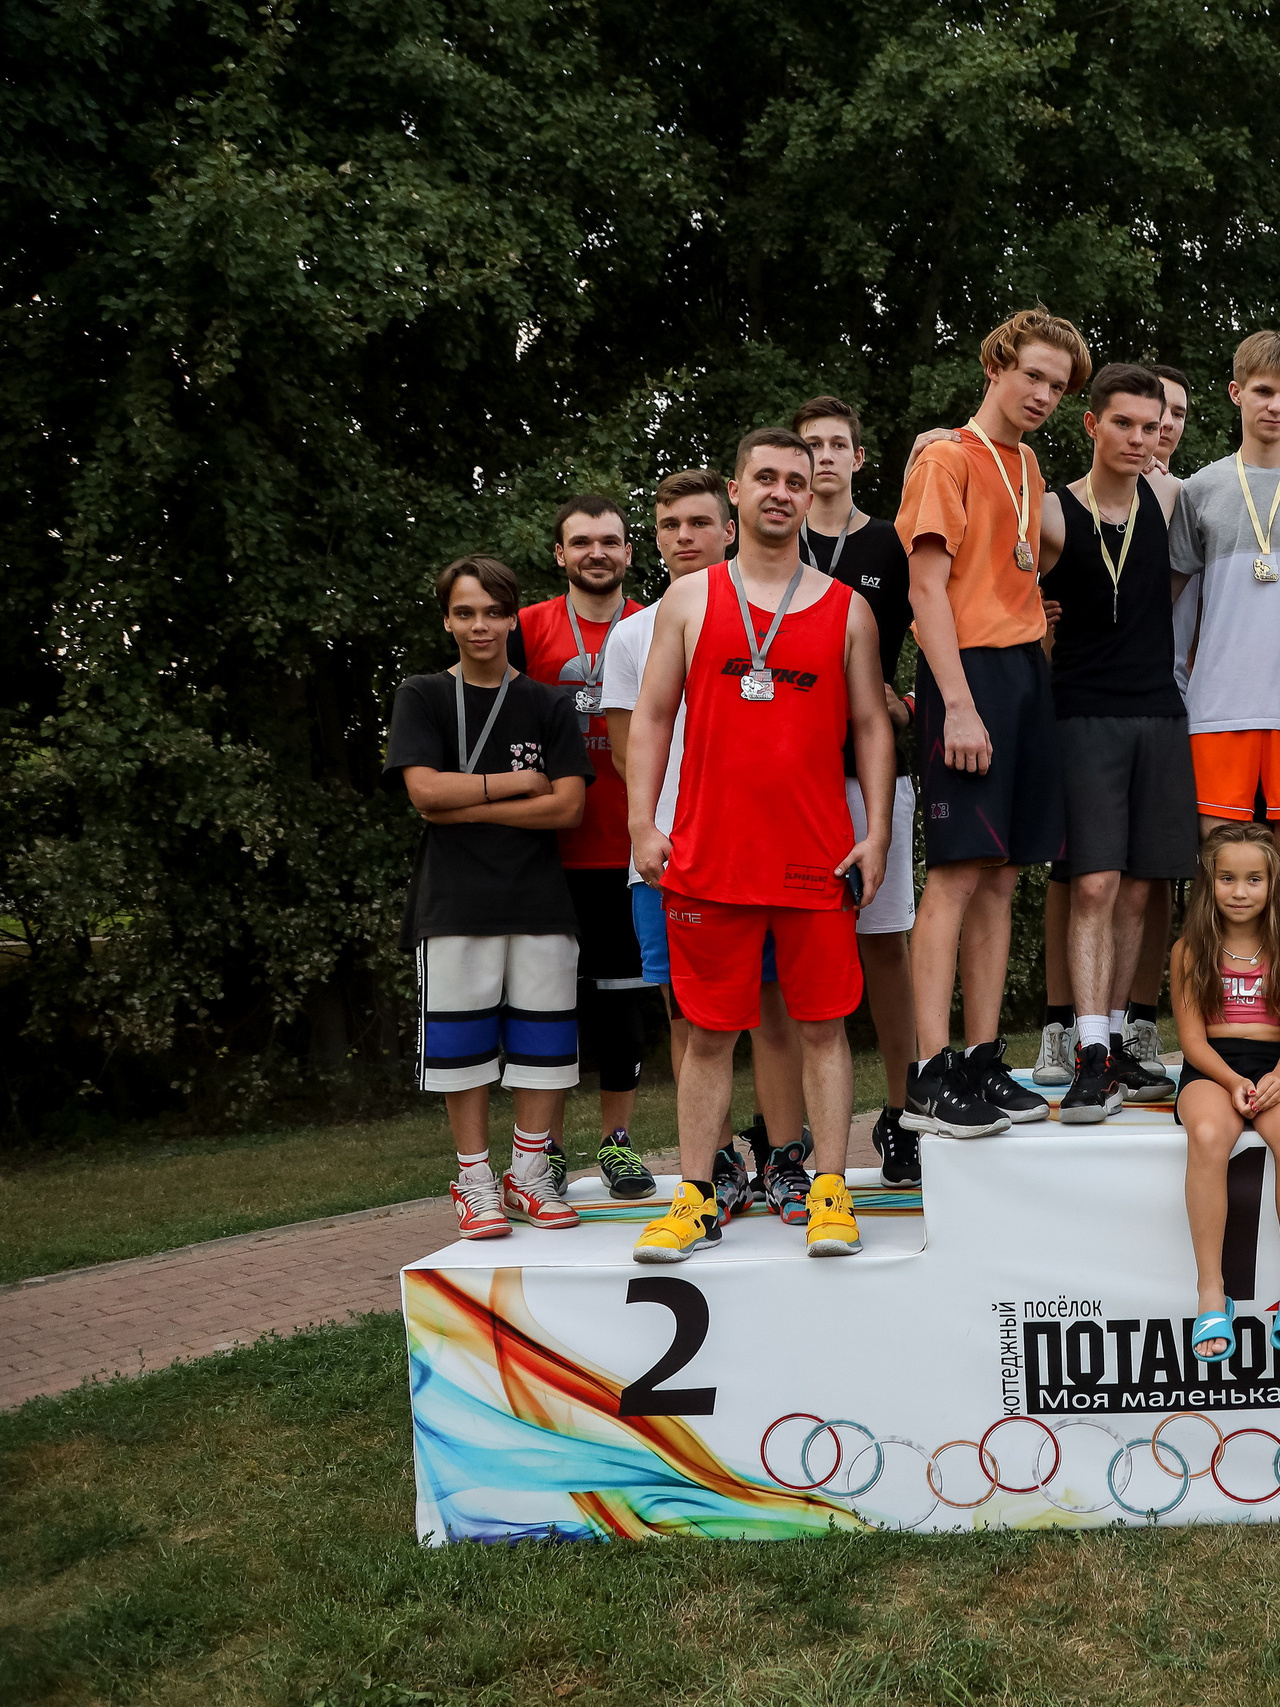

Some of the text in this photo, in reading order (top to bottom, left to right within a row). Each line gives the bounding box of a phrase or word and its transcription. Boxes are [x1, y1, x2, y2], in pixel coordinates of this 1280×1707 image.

[861, 575, 880, 586] EA7
[669, 908, 702, 924] ELITE
[1221, 977, 1263, 996] FILA
[1222, 1146, 1267, 1301] 1
[1024, 1295, 1102, 1318] посёлок
[618, 1276, 717, 1417] 2
[992, 1301, 1024, 1416] коттеджный
[1039, 1389, 1109, 1409] Моя
